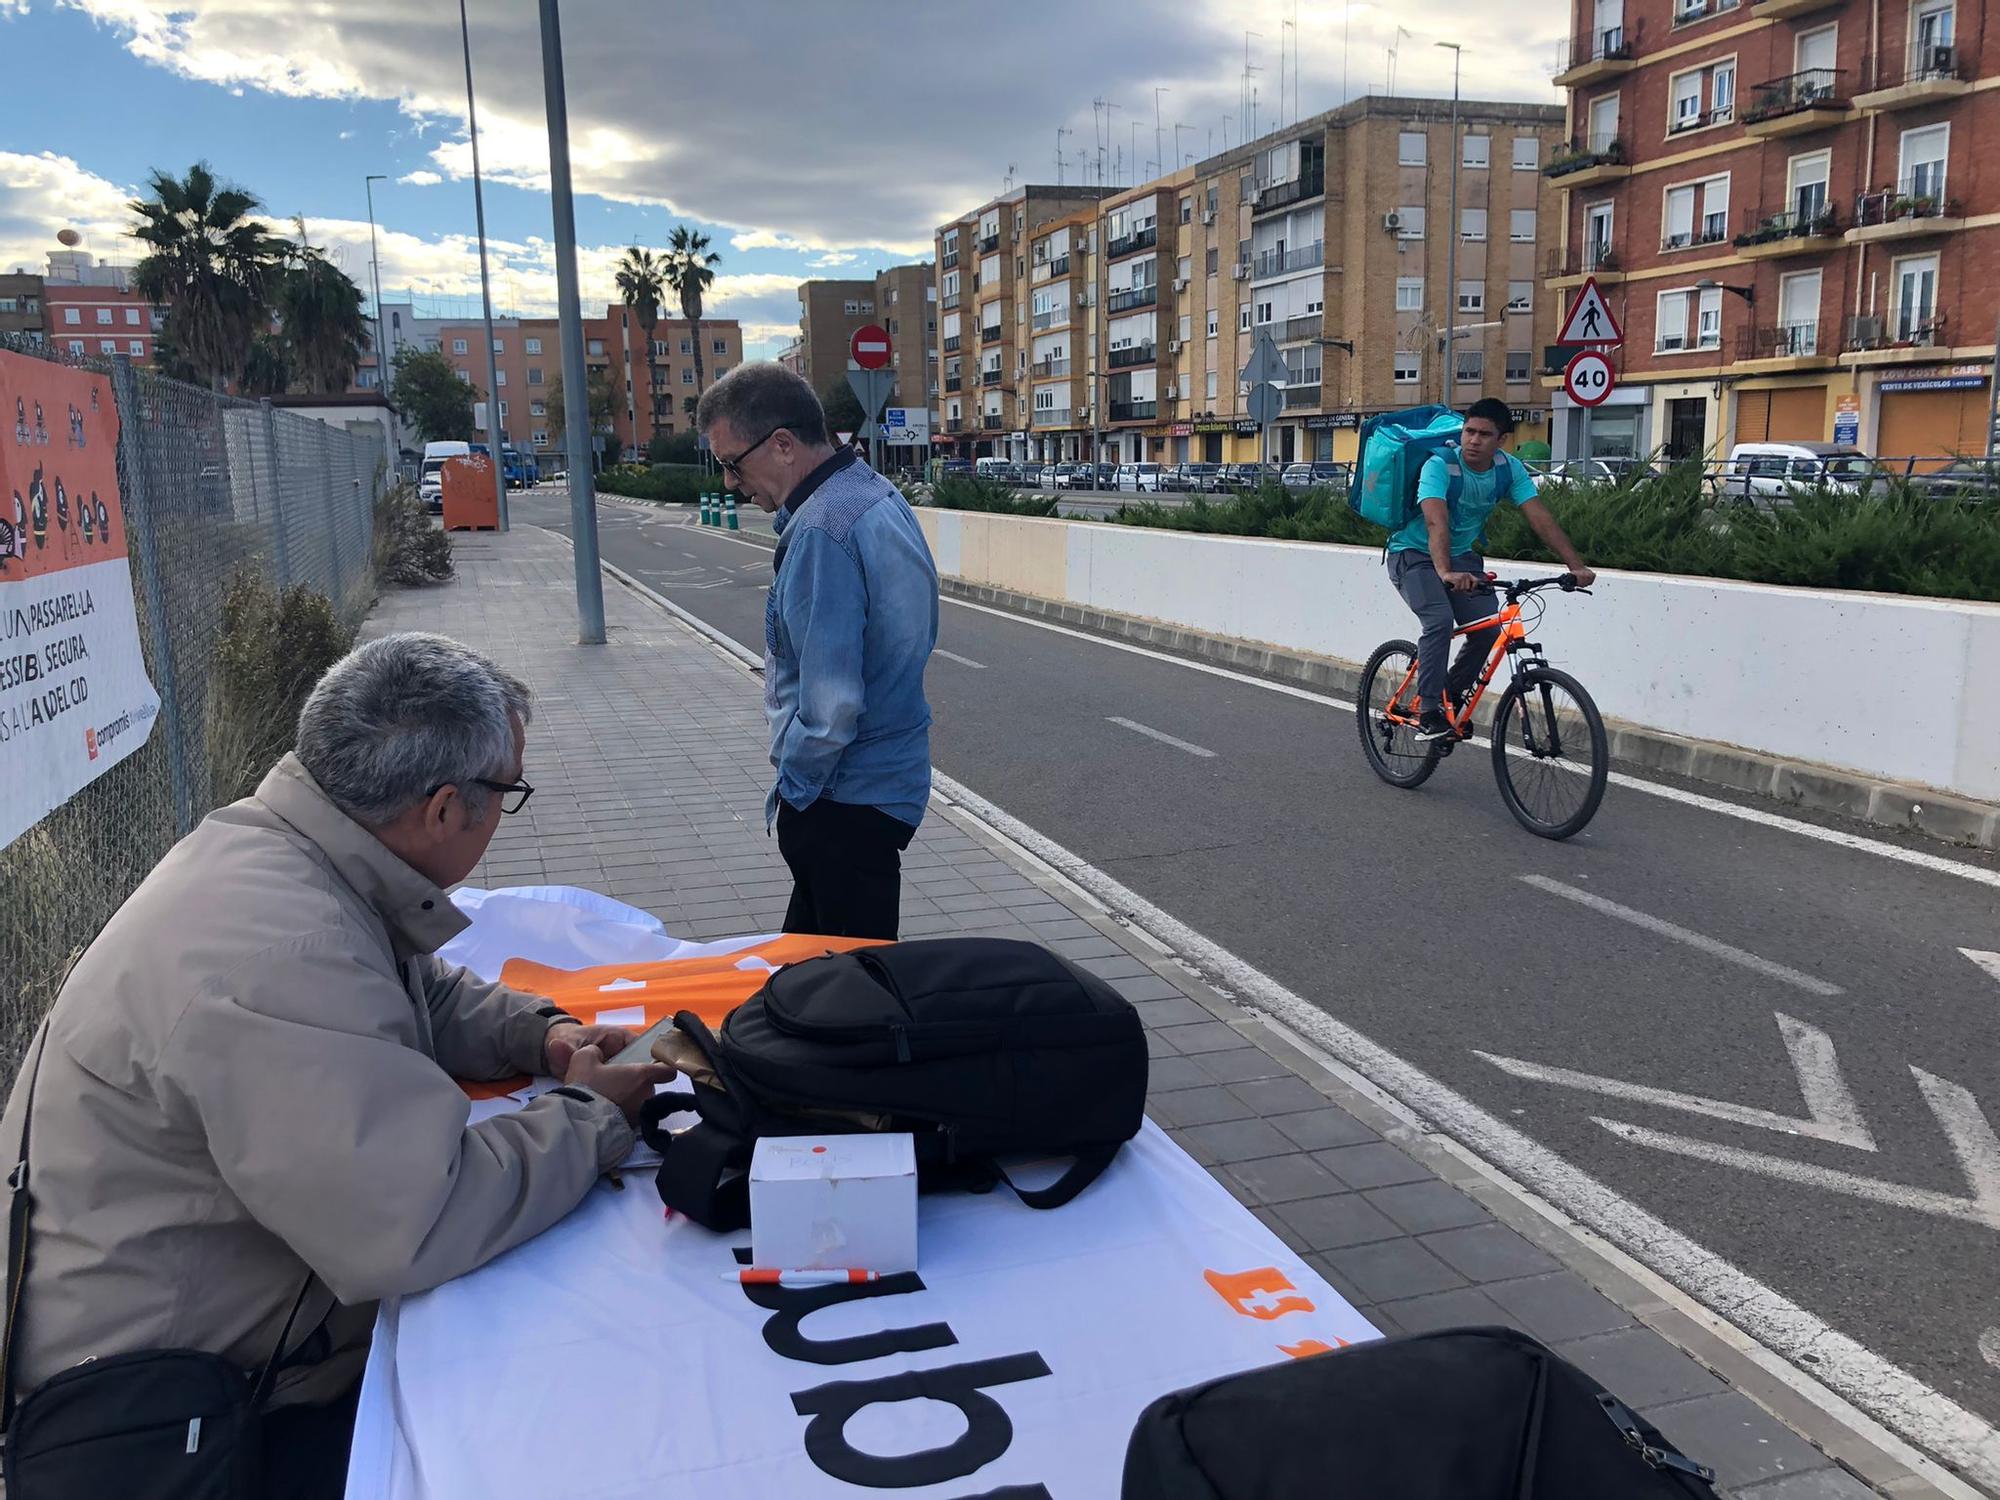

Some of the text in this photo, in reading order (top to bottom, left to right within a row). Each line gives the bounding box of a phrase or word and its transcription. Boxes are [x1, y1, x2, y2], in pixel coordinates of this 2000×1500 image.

[1951, 364, 1982, 375] CARS
[1574, 370, 1606, 388] 40
[70, 676, 88, 706] CID
